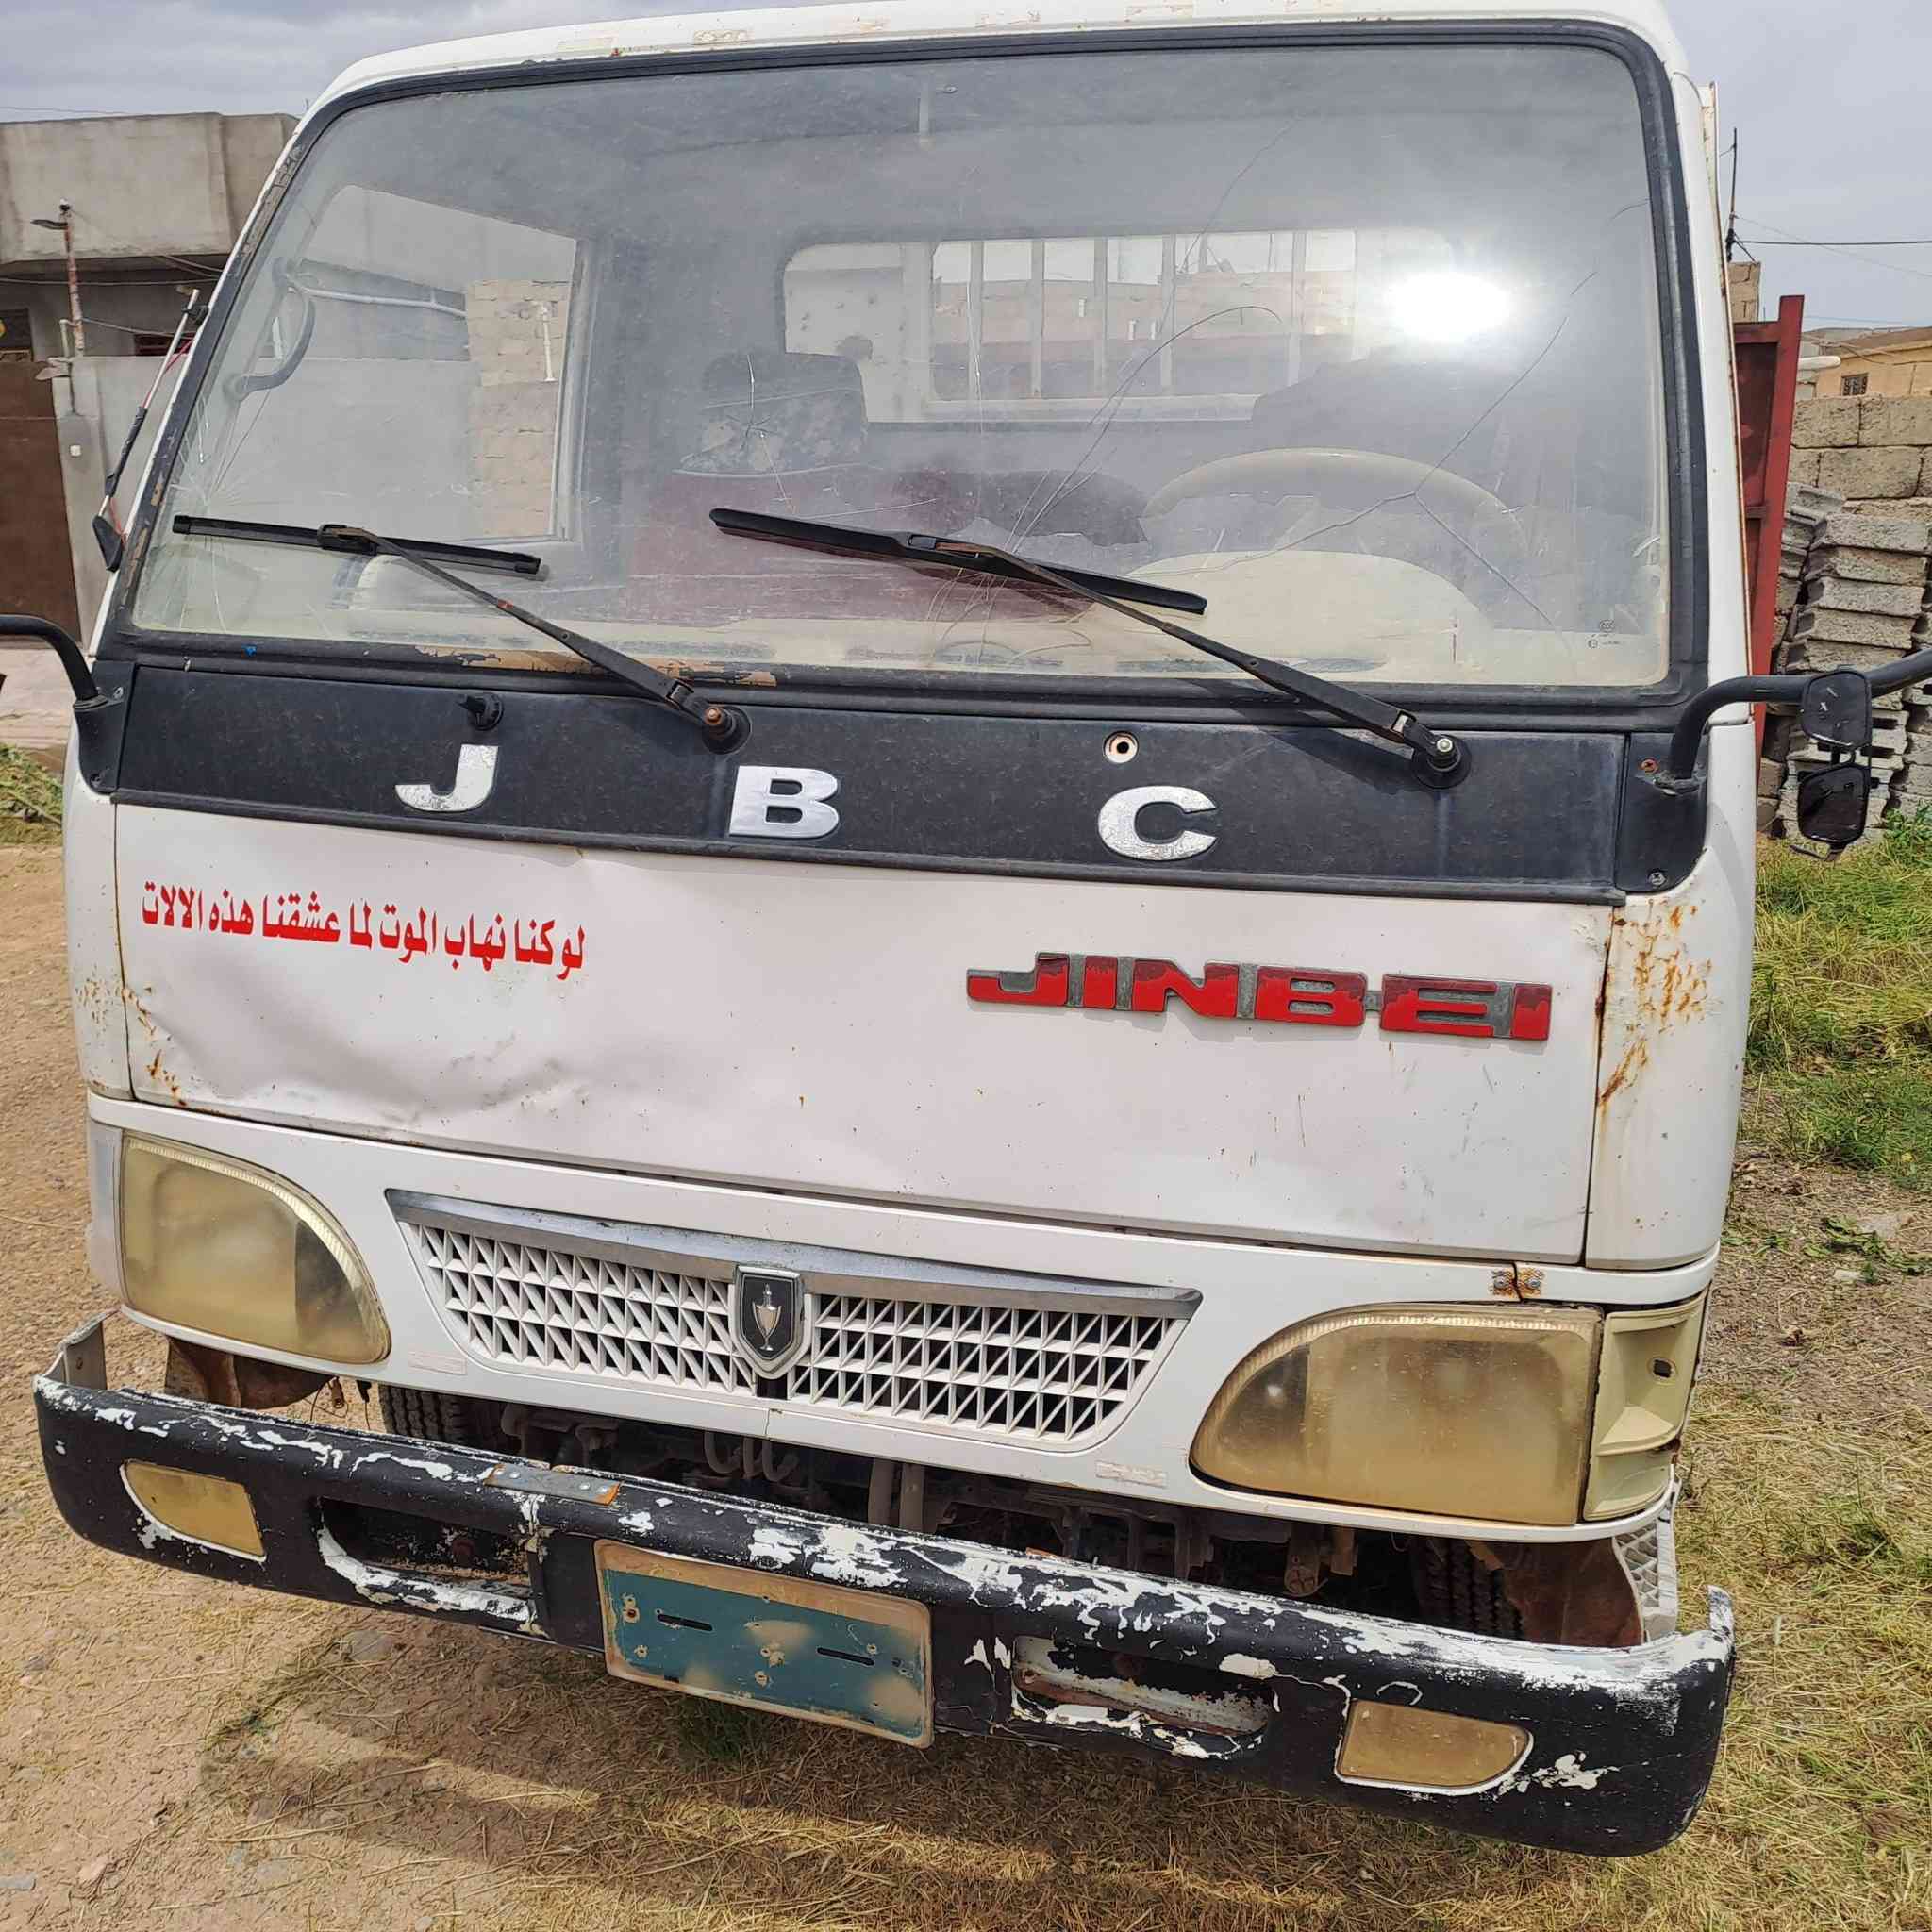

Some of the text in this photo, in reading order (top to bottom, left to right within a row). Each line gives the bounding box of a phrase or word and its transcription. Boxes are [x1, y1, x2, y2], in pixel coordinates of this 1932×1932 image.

[208, 888, 256, 937] هذه
[261, 891, 343, 944] عشقنا
[348, 898, 375, 951] لما
[378, 906, 440, 965] الموت
[443, 912, 508, 973] نهاب
[513, 917, 557, 966] كنا
[558, 924, 586, 982] لو
[965, 951, 1557, 1042] JINBEI
